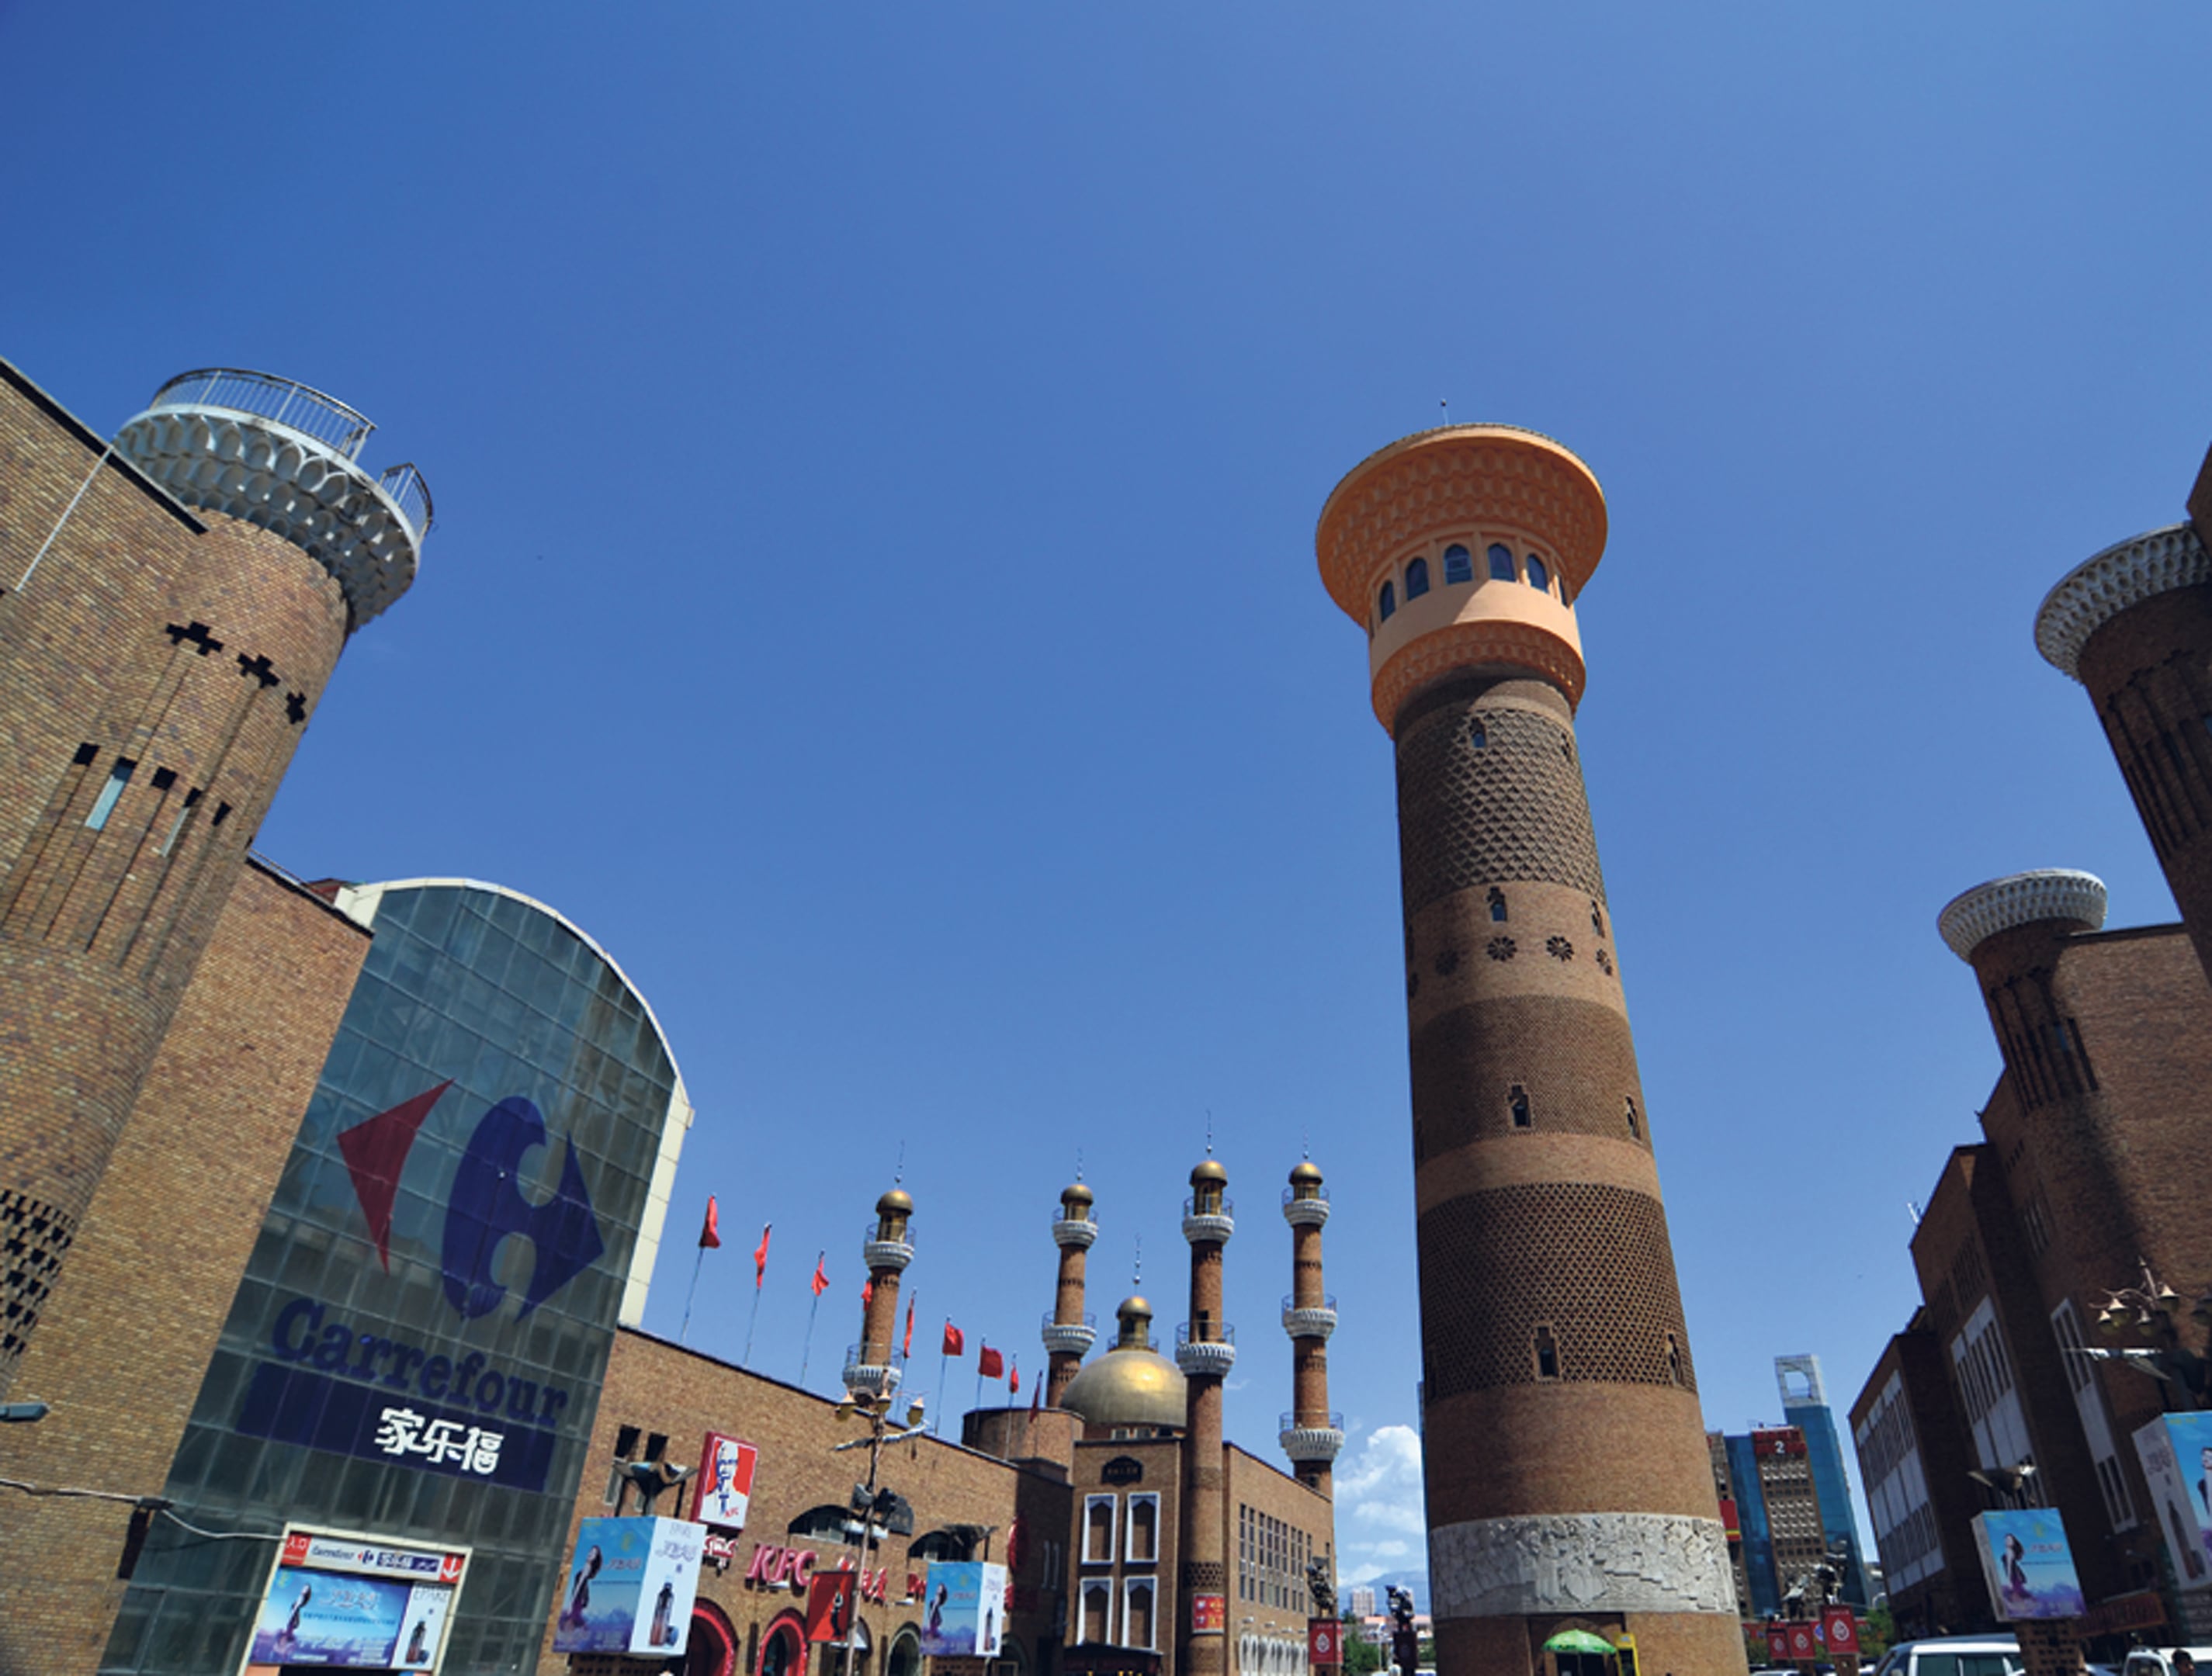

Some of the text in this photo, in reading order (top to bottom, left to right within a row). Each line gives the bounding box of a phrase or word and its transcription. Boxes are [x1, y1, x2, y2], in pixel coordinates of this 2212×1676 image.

[273, 1297, 567, 1425] Carrefour
[374, 1408, 504, 1474] 家乐福
[1774, 1440, 1785, 1453] 2
[745, 1543, 818, 1587] KFC
